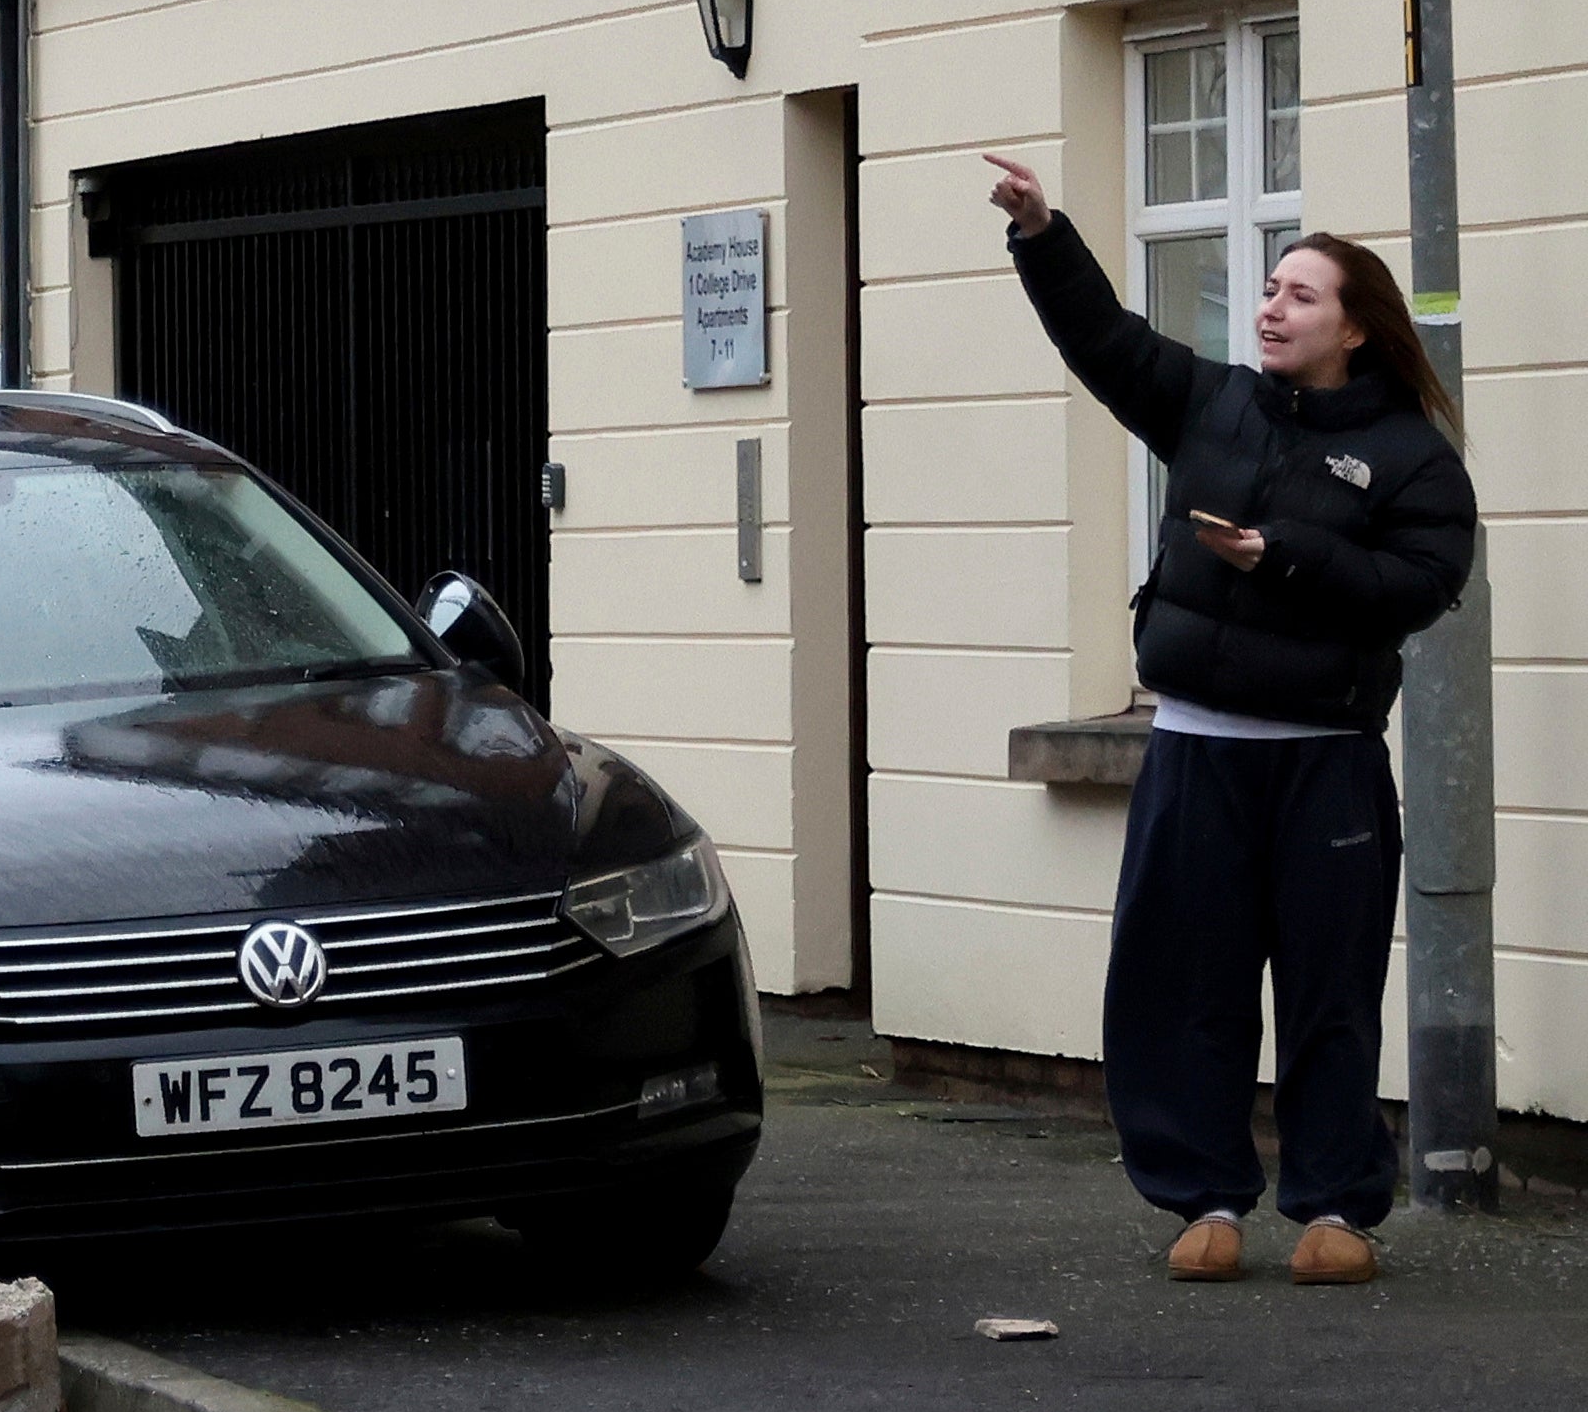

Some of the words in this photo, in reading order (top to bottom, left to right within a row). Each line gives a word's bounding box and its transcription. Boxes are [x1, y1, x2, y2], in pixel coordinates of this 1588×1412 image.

[686, 239, 727, 265] Academy
[729, 235, 759, 258] House
[689, 275, 694, 296] 1
[697, 273, 730, 299] College
[732, 269, 757, 293] Drive
[697, 306, 748, 333] Apartments
[159, 1065, 273, 1125] WFZ
[290, 1050, 438, 1114] 8245
